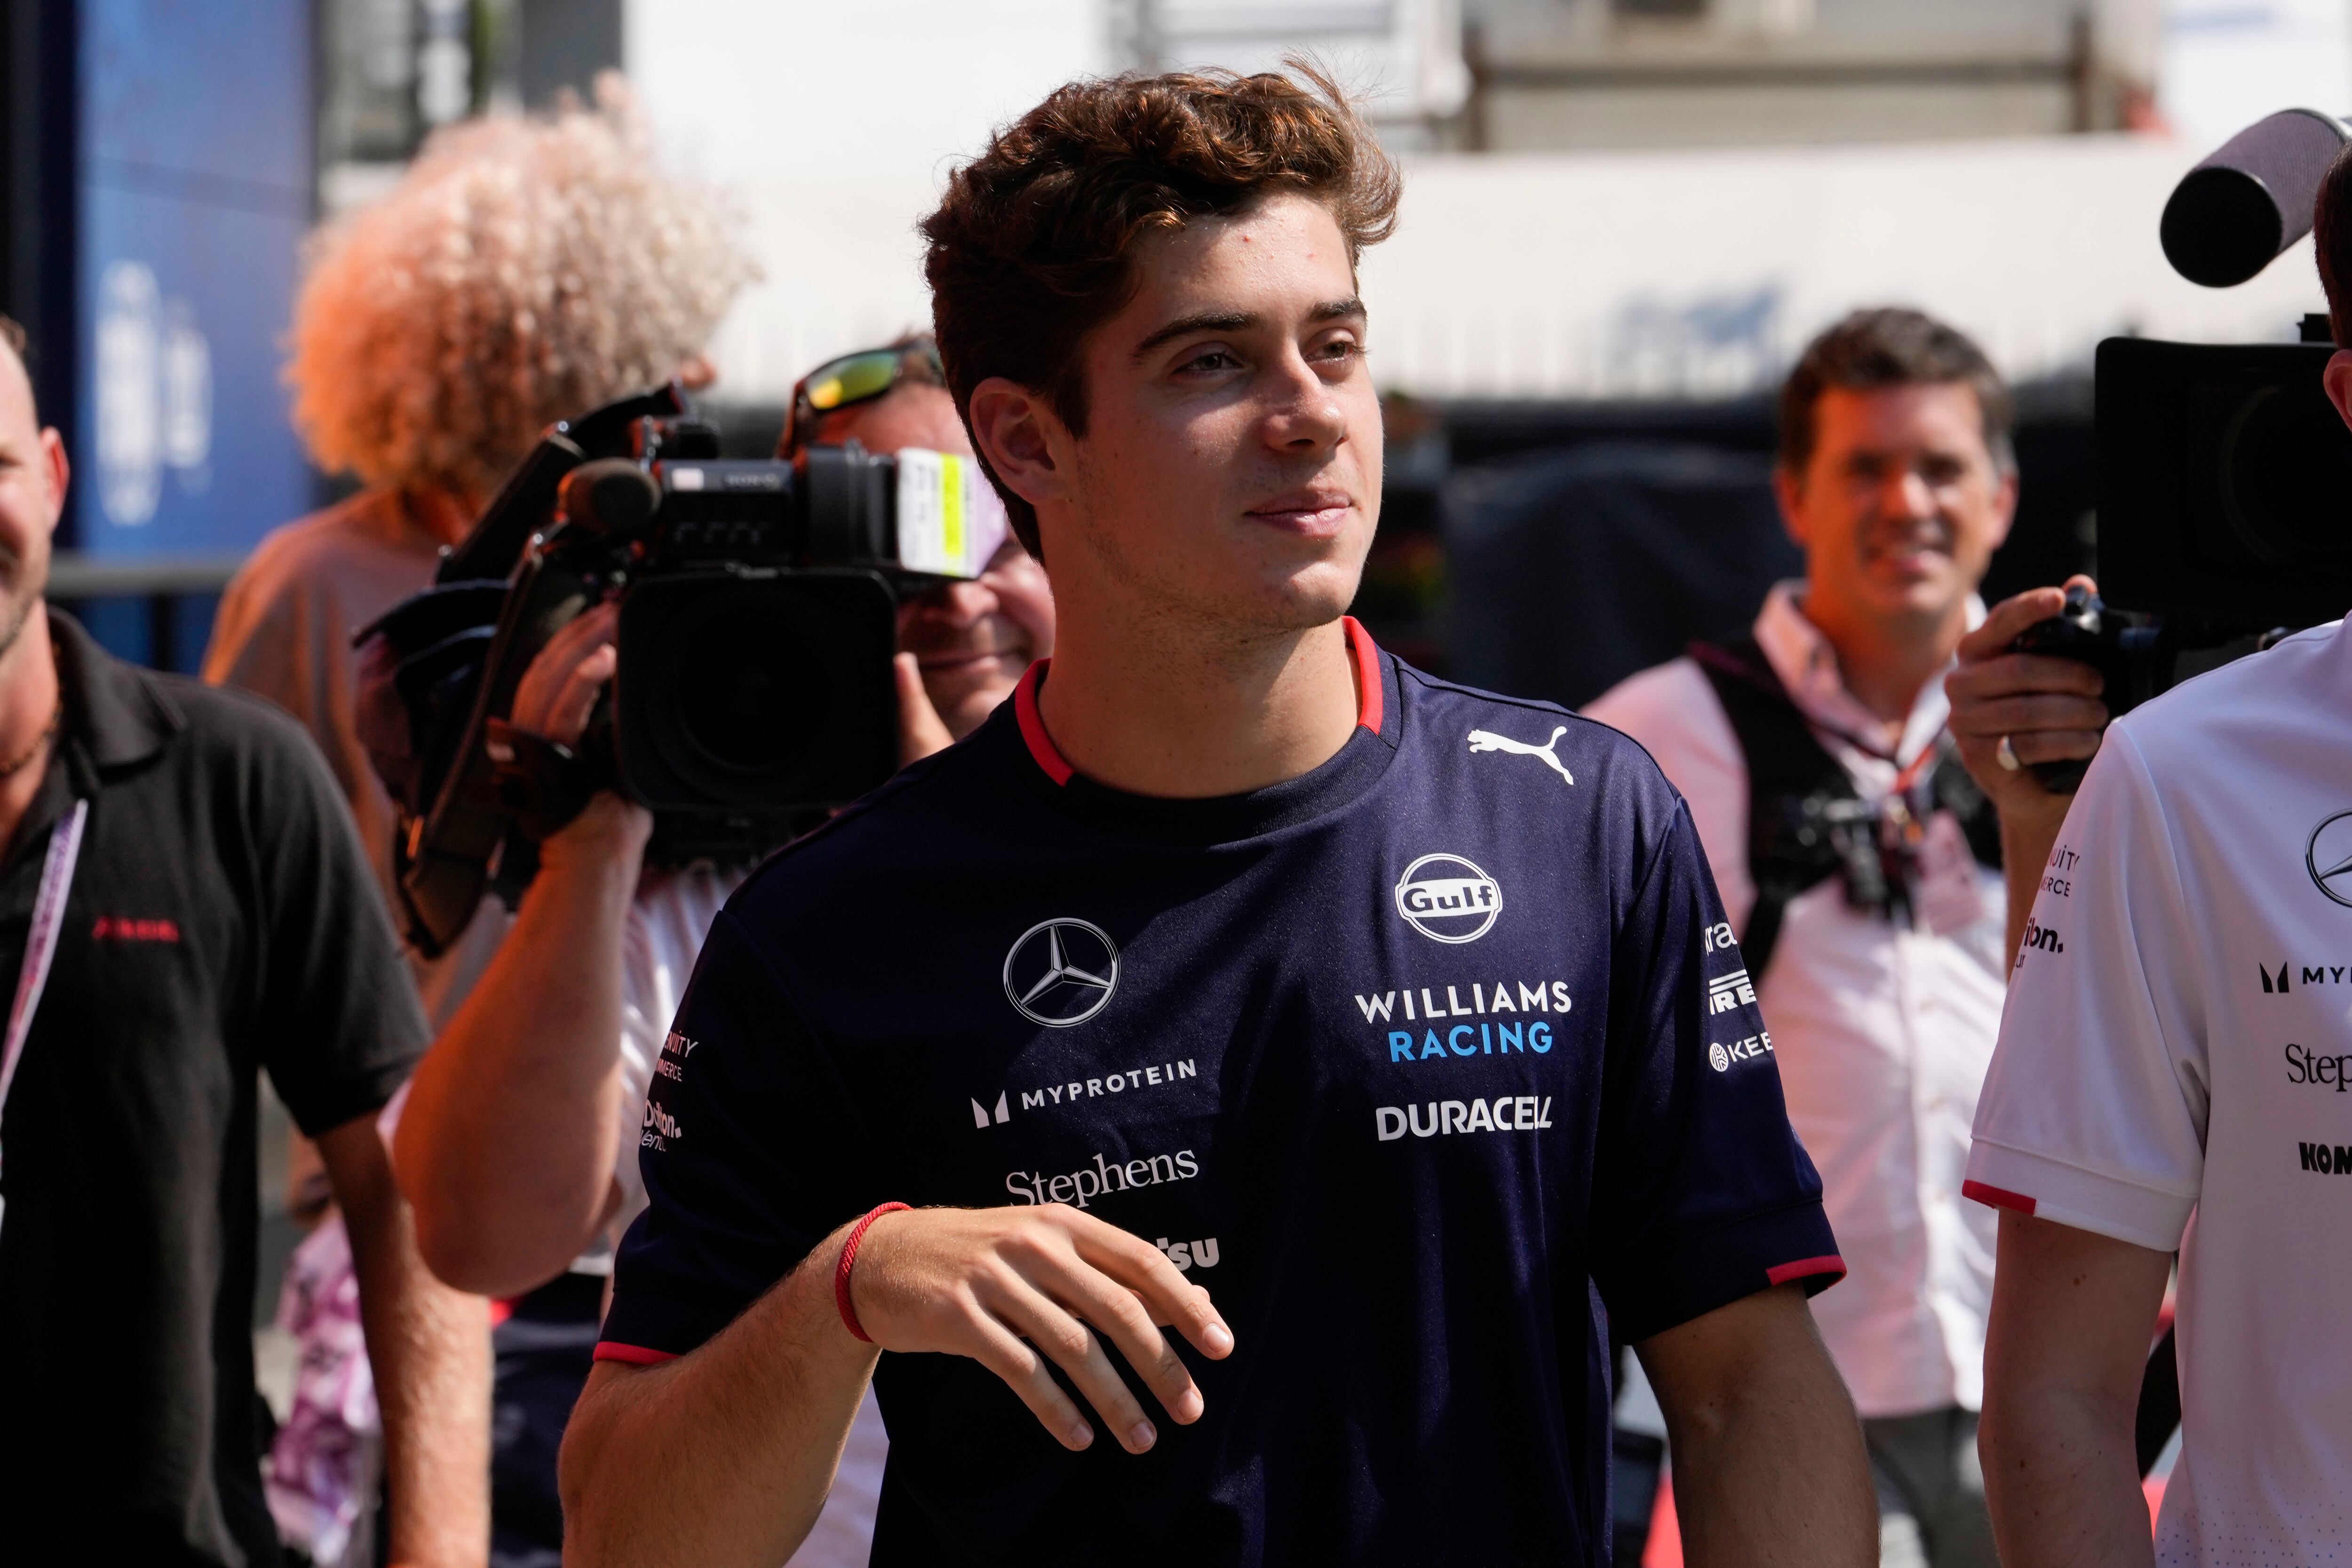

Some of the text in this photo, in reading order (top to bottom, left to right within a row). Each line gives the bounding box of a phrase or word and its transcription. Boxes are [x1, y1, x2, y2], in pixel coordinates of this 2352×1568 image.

[1403, 885, 1493, 912] Gulf
[2303, 967, 2352, 985] MY
[1355, 980, 1572, 1024] WILLIAMS
[1388, 1021, 1552, 1062] RACING
[1021, 1059, 1197, 1110] MYPROTEIN
[1376, 1096, 1553, 1141] DURACELL
[1006, 1149, 1199, 1209] Stephens
